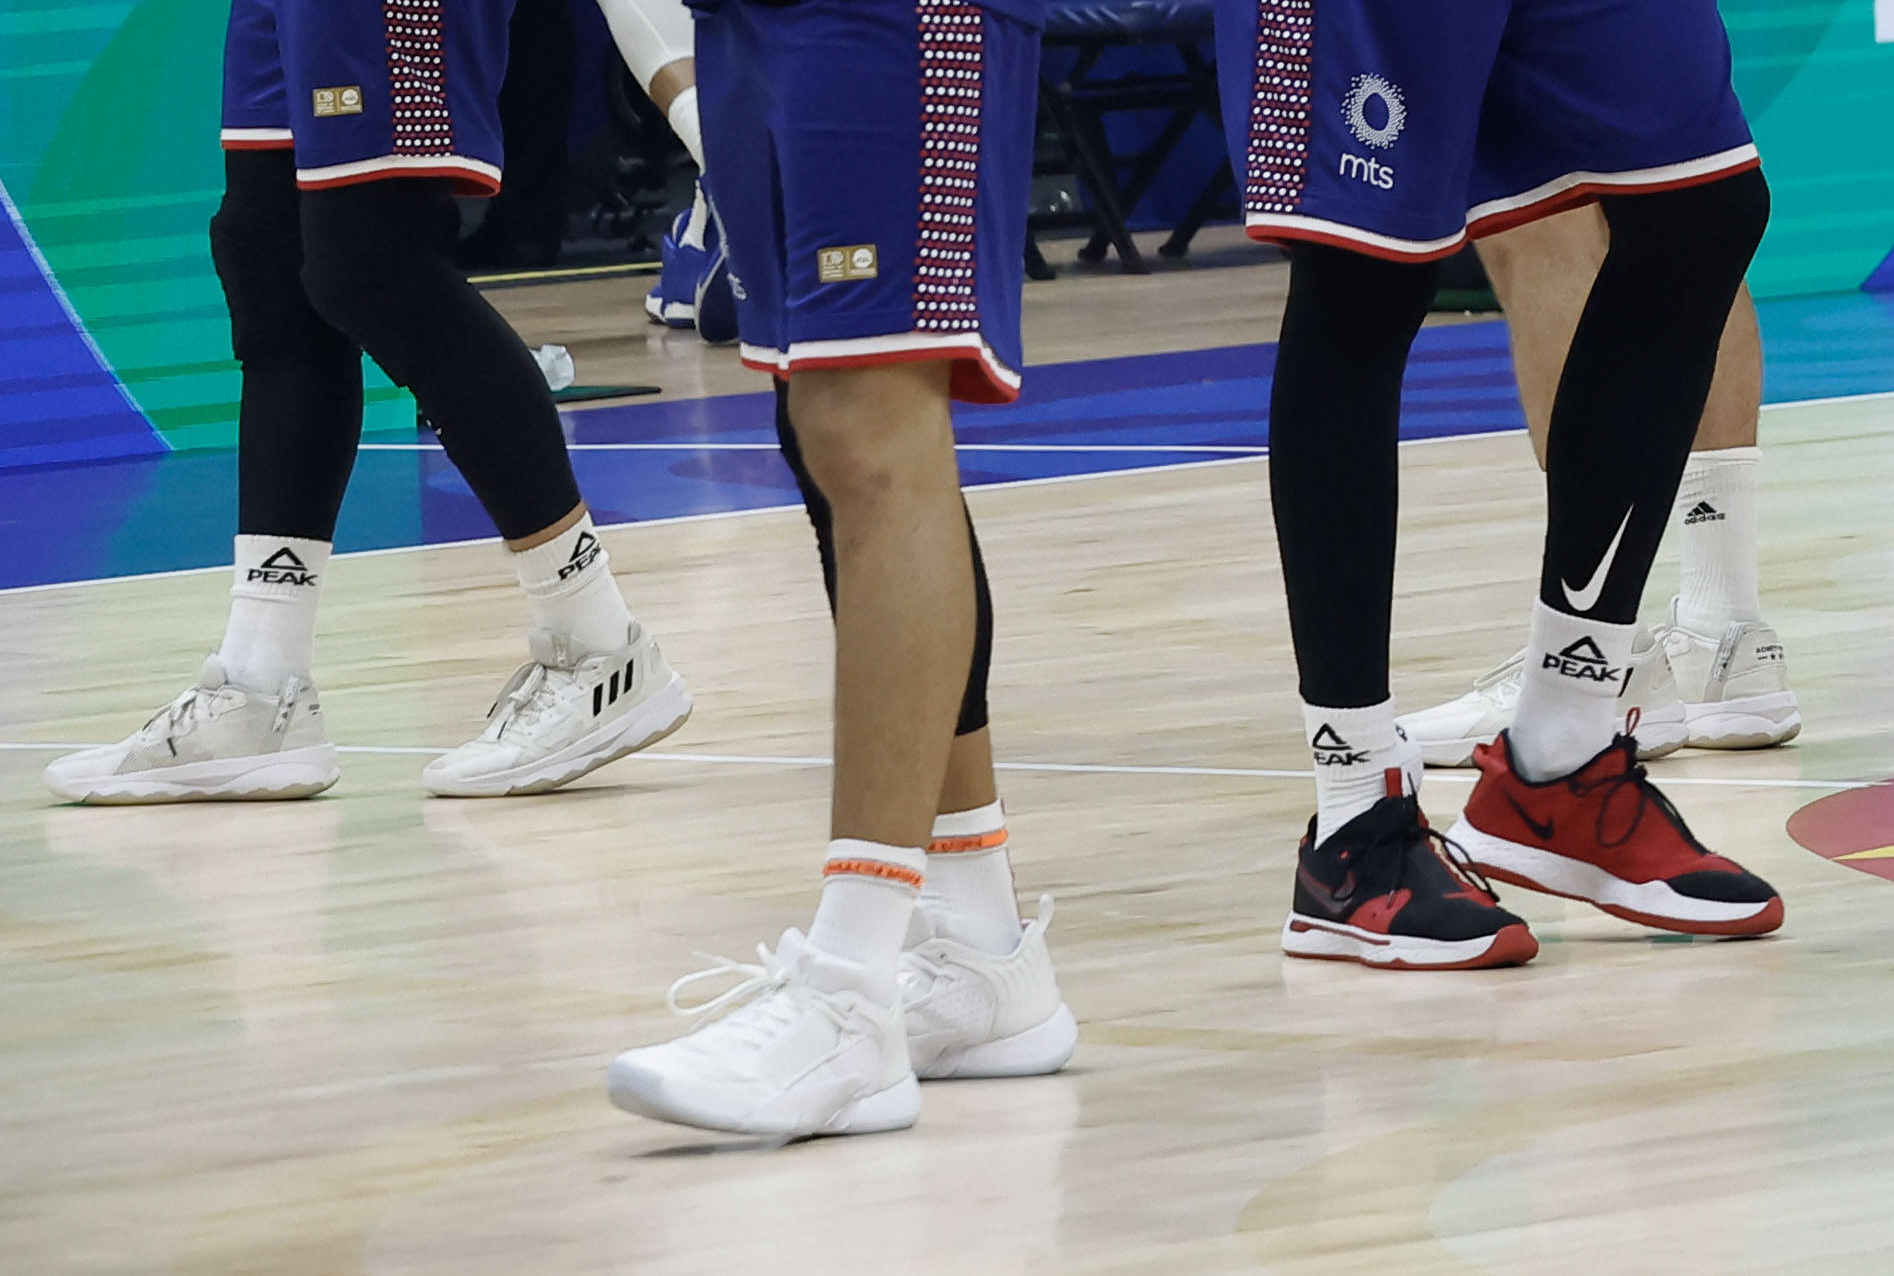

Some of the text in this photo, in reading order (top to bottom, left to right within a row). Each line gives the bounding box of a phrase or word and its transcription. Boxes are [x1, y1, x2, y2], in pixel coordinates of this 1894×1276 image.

[1338, 151, 1395, 189] mts
[246, 568, 318, 587] PEAK
[1542, 652, 1621, 683] PEAK
